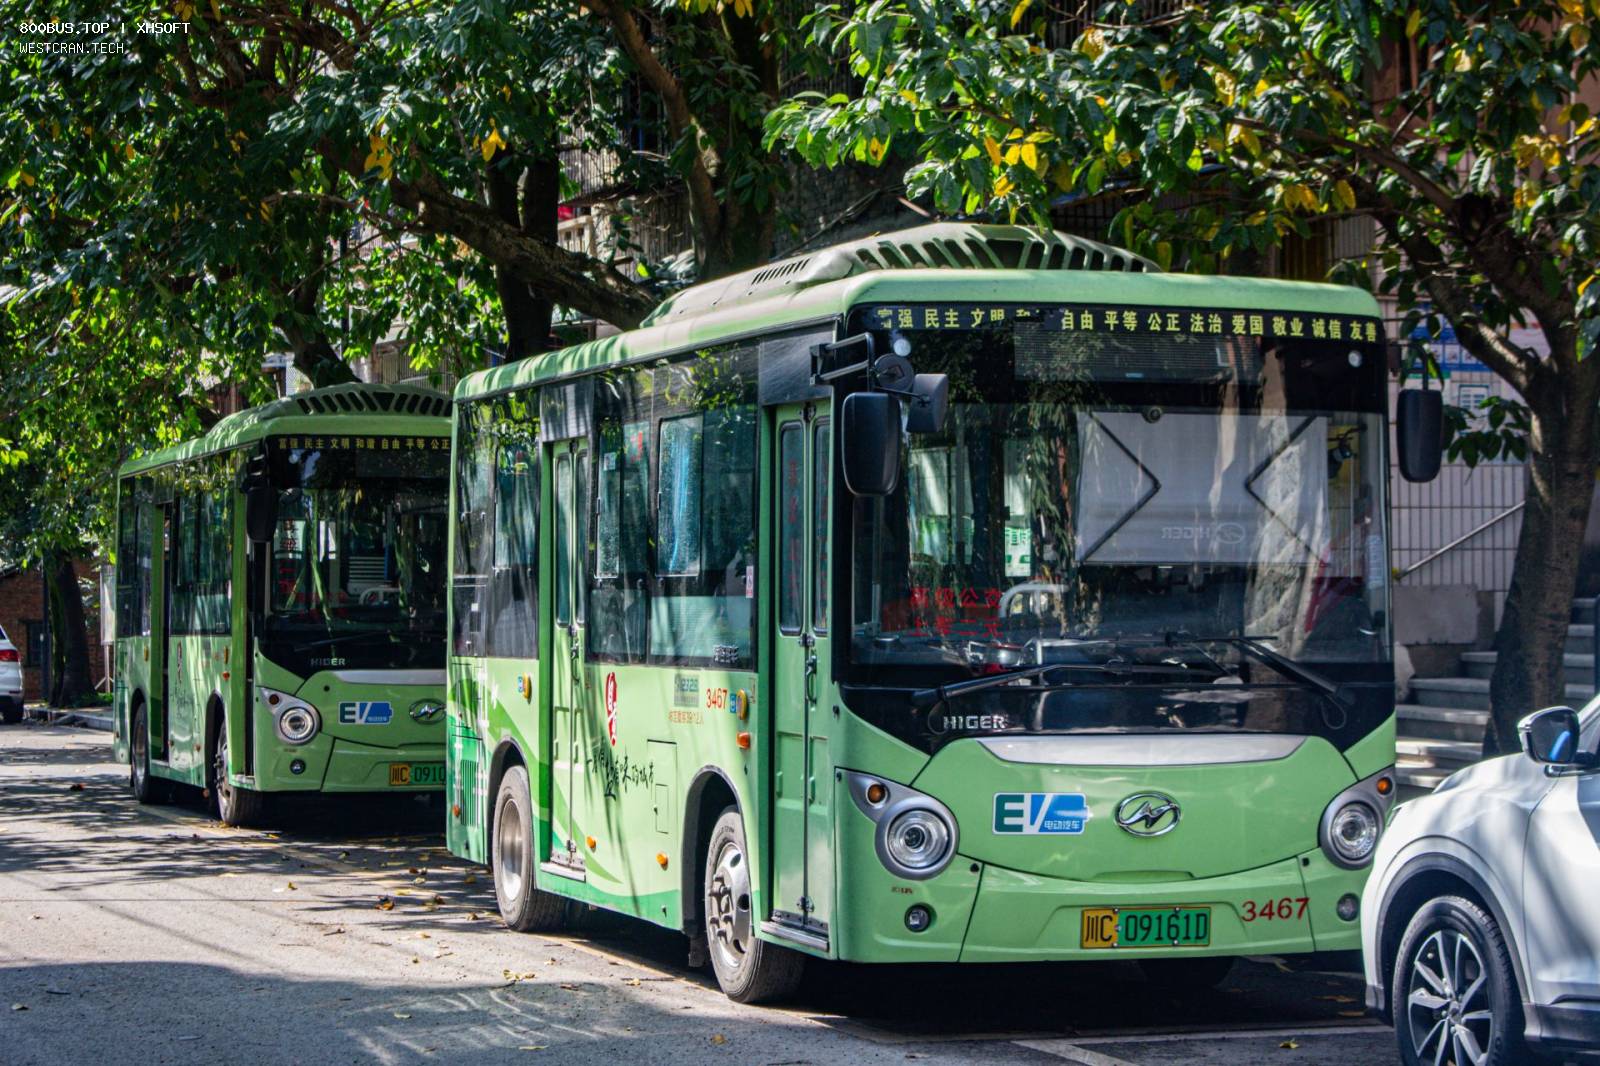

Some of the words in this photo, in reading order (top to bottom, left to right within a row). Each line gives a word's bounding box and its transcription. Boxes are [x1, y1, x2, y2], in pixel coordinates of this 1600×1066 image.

[924, 308, 960, 328] 民主
[1061, 309, 1094, 330] 自由
[1104, 310, 1138, 332] 平等
[1147, 312, 1181, 332] 公正
[1190, 313, 1223, 334] 法治
[1231, 315, 1264, 335] 爱国
[1272, 316, 1304, 337] 敬业
[1312, 318, 1342, 340] 诚信
[1350, 320, 1377, 342] 友善
[706, 688, 728, 709] 3467
[943, 714, 1006, 729] HIGER
[995, 793, 1054, 833] EV
[1044, 820, 1080, 830] 电动汽车
[1241, 897, 1310, 922] 3467
[1124, 913, 1208, 941] 09161D
